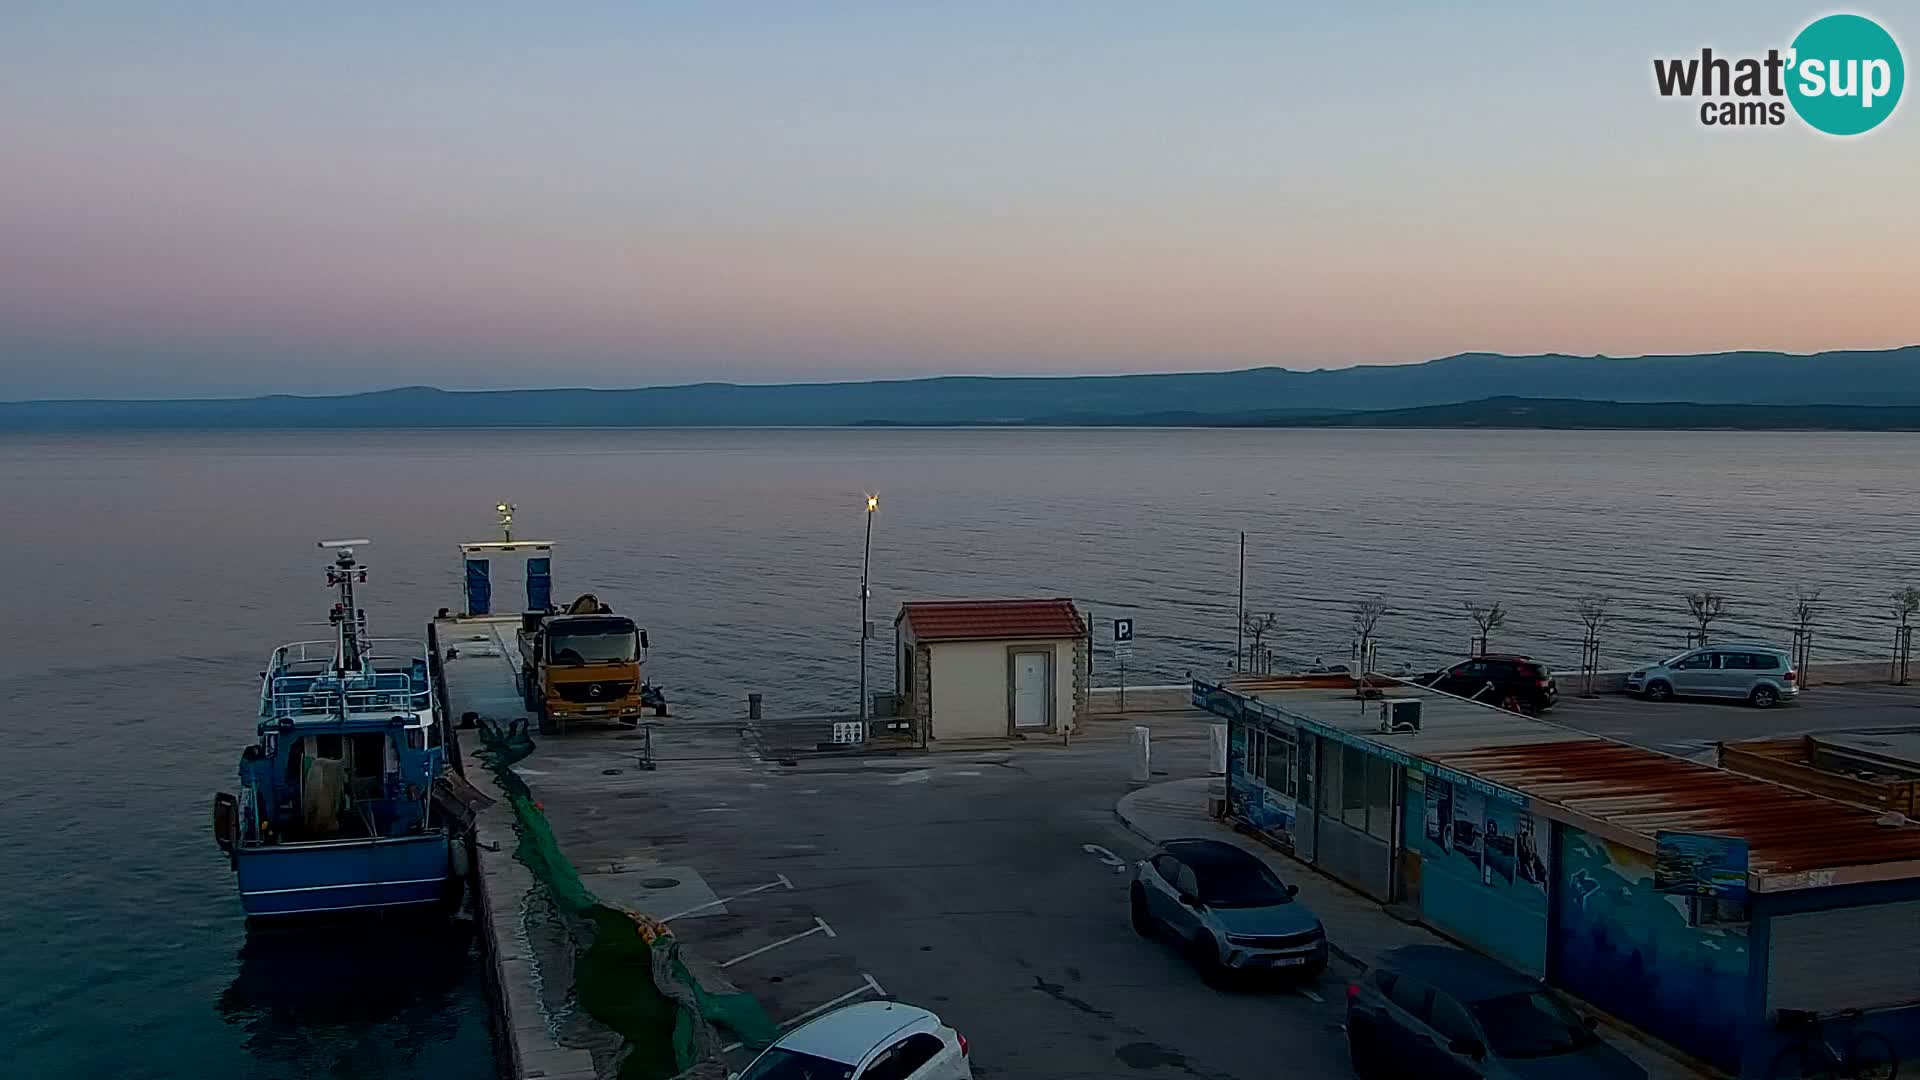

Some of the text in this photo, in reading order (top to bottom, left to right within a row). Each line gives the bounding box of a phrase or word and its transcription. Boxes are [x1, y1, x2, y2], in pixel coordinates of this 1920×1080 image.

[1118, 621, 1129, 638] P
[1470, 778, 1495, 796] TICKET
[1497, 790, 1525, 806] OFFICE
